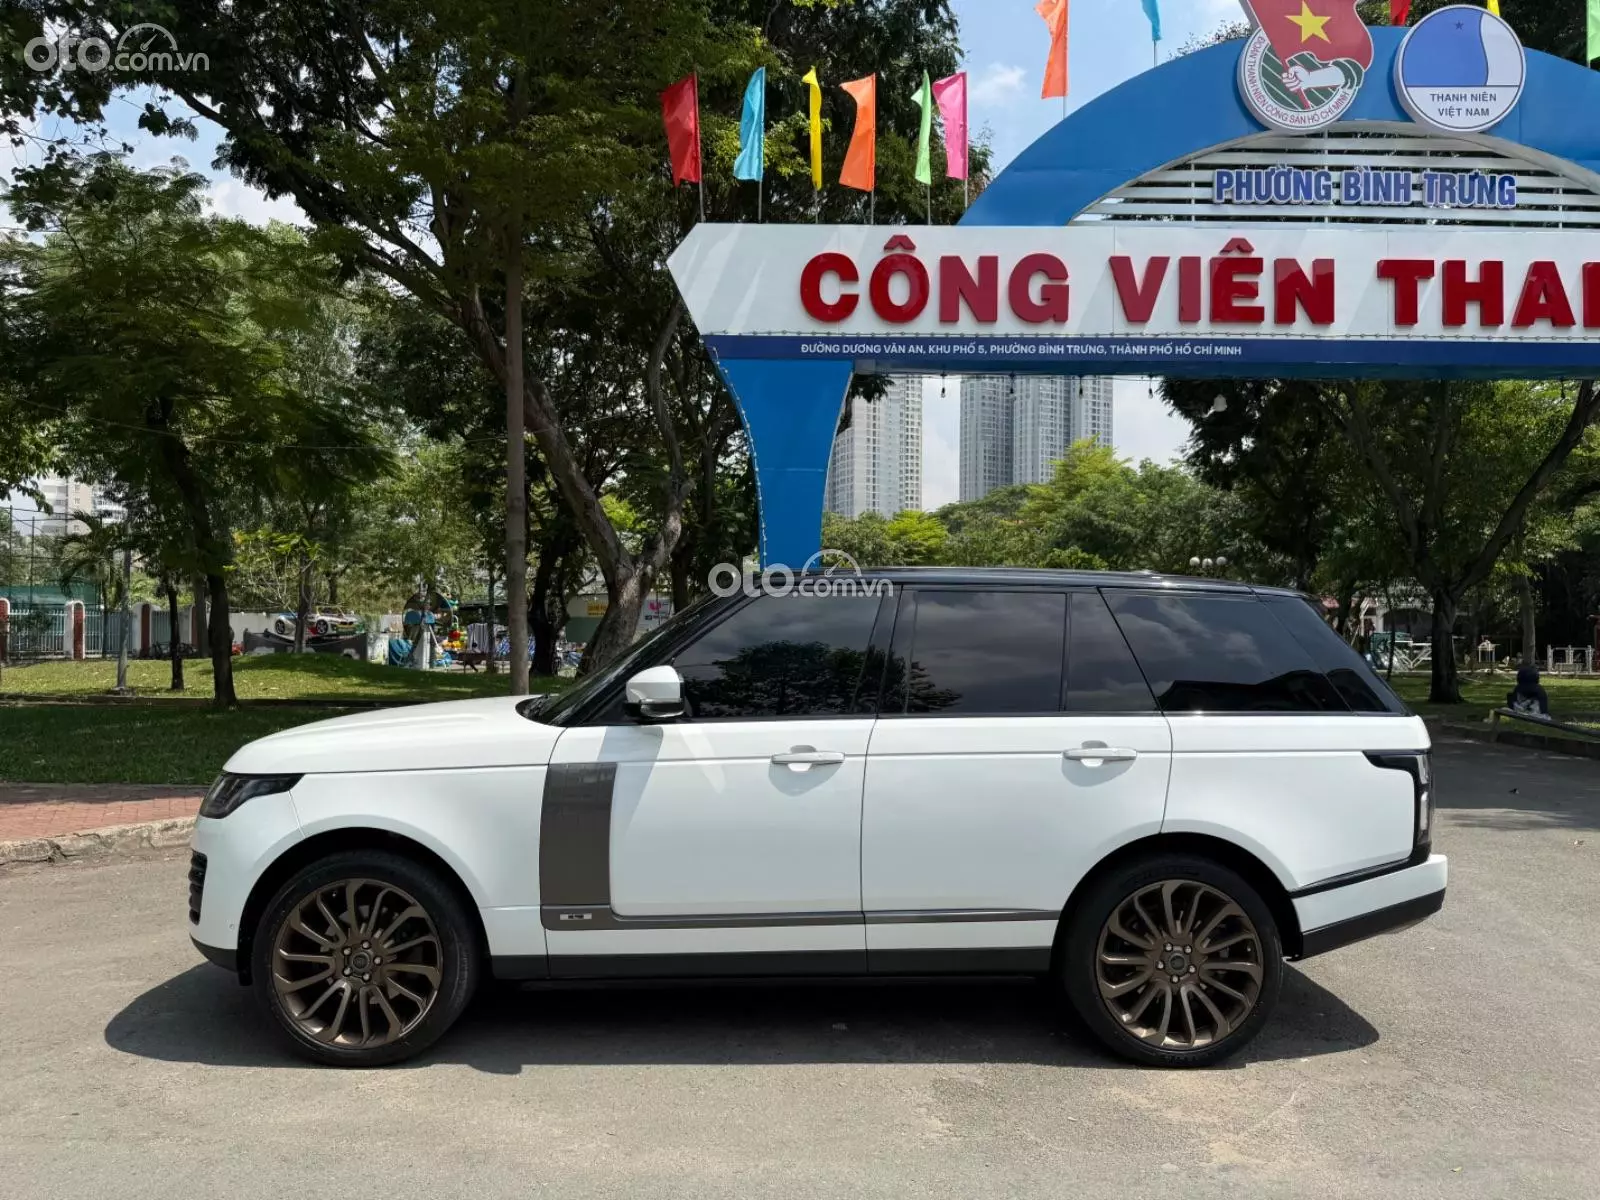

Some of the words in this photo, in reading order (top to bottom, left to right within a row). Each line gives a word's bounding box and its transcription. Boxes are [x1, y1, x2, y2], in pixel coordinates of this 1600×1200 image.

[1332, 92, 1350, 112] MINH
[1430, 93, 1467, 102] THANH
[1471, 91, 1497, 102] NIÊN
[1438, 105, 1462, 118] VIỆT
[1466, 107, 1490, 116] NAM
[1341, 166, 1413, 204] BÌNH
[1422, 170, 1517, 206] TRƯNG
[800, 235, 1070, 323] CÔNG
[1109, 237, 1335, 324] VIÊN
[801, 342, 840, 354] ĐƯỜNG
[843, 343, 882, 354] DƯƠNG
[884, 342, 905, 354] VĂN
[908, 344, 926, 355] AN,
[929, 344, 950, 354] KHU
[953, 342, 976, 354] PHỐ
[978, 344, 988, 355] 5,
[990, 342, 1036, 354] PHƯỜNG
[1039, 342, 1064, 354] BÌNH
[1067, 343, 1107, 355] TRƯNG,
[1110, 342, 1147, 354] THÀNH
[1150, 342, 1173, 354] PHỐ
[1176, 342, 1192, 354] HỒ
[1194, 343, 1213, 355] CHÍ
[1215, 345, 1242, 355] MINH
